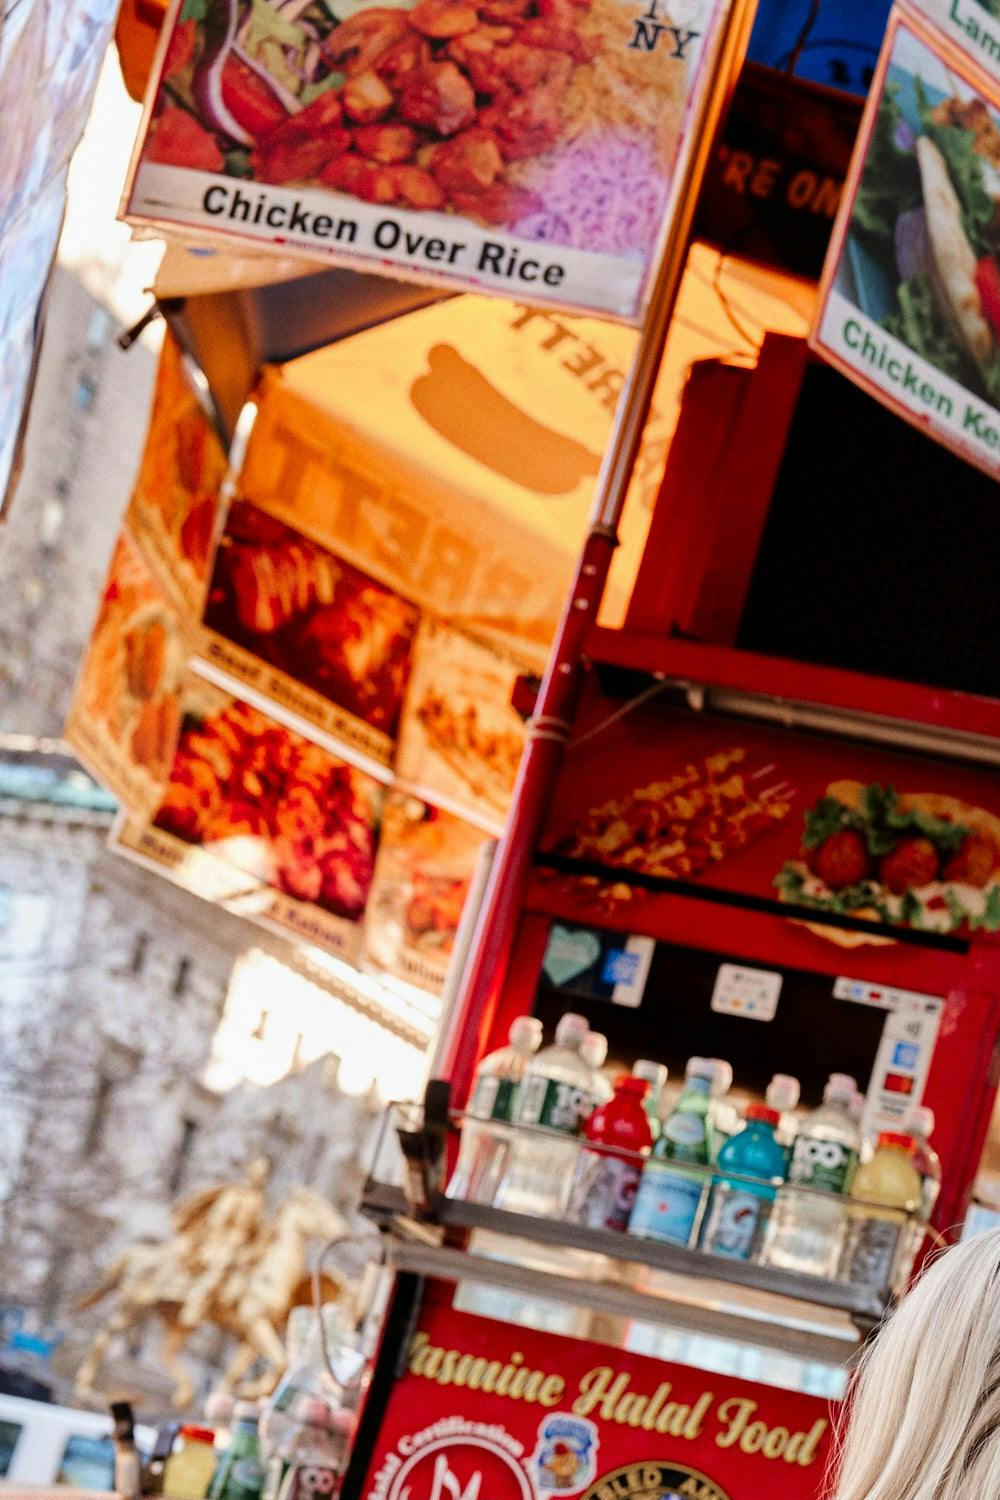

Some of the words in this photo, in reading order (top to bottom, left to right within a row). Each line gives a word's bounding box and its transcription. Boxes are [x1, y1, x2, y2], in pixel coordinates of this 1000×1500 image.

[629, 20, 700, 59] NY
[202, 184, 357, 243] Chicken
[373, 220, 466, 265] Over
[477, 241, 567, 287] Rice
[842, 319, 953, 418] Chicken
[571, 1365, 715, 1441] Halal
[714, 1396, 830, 1467] Food
